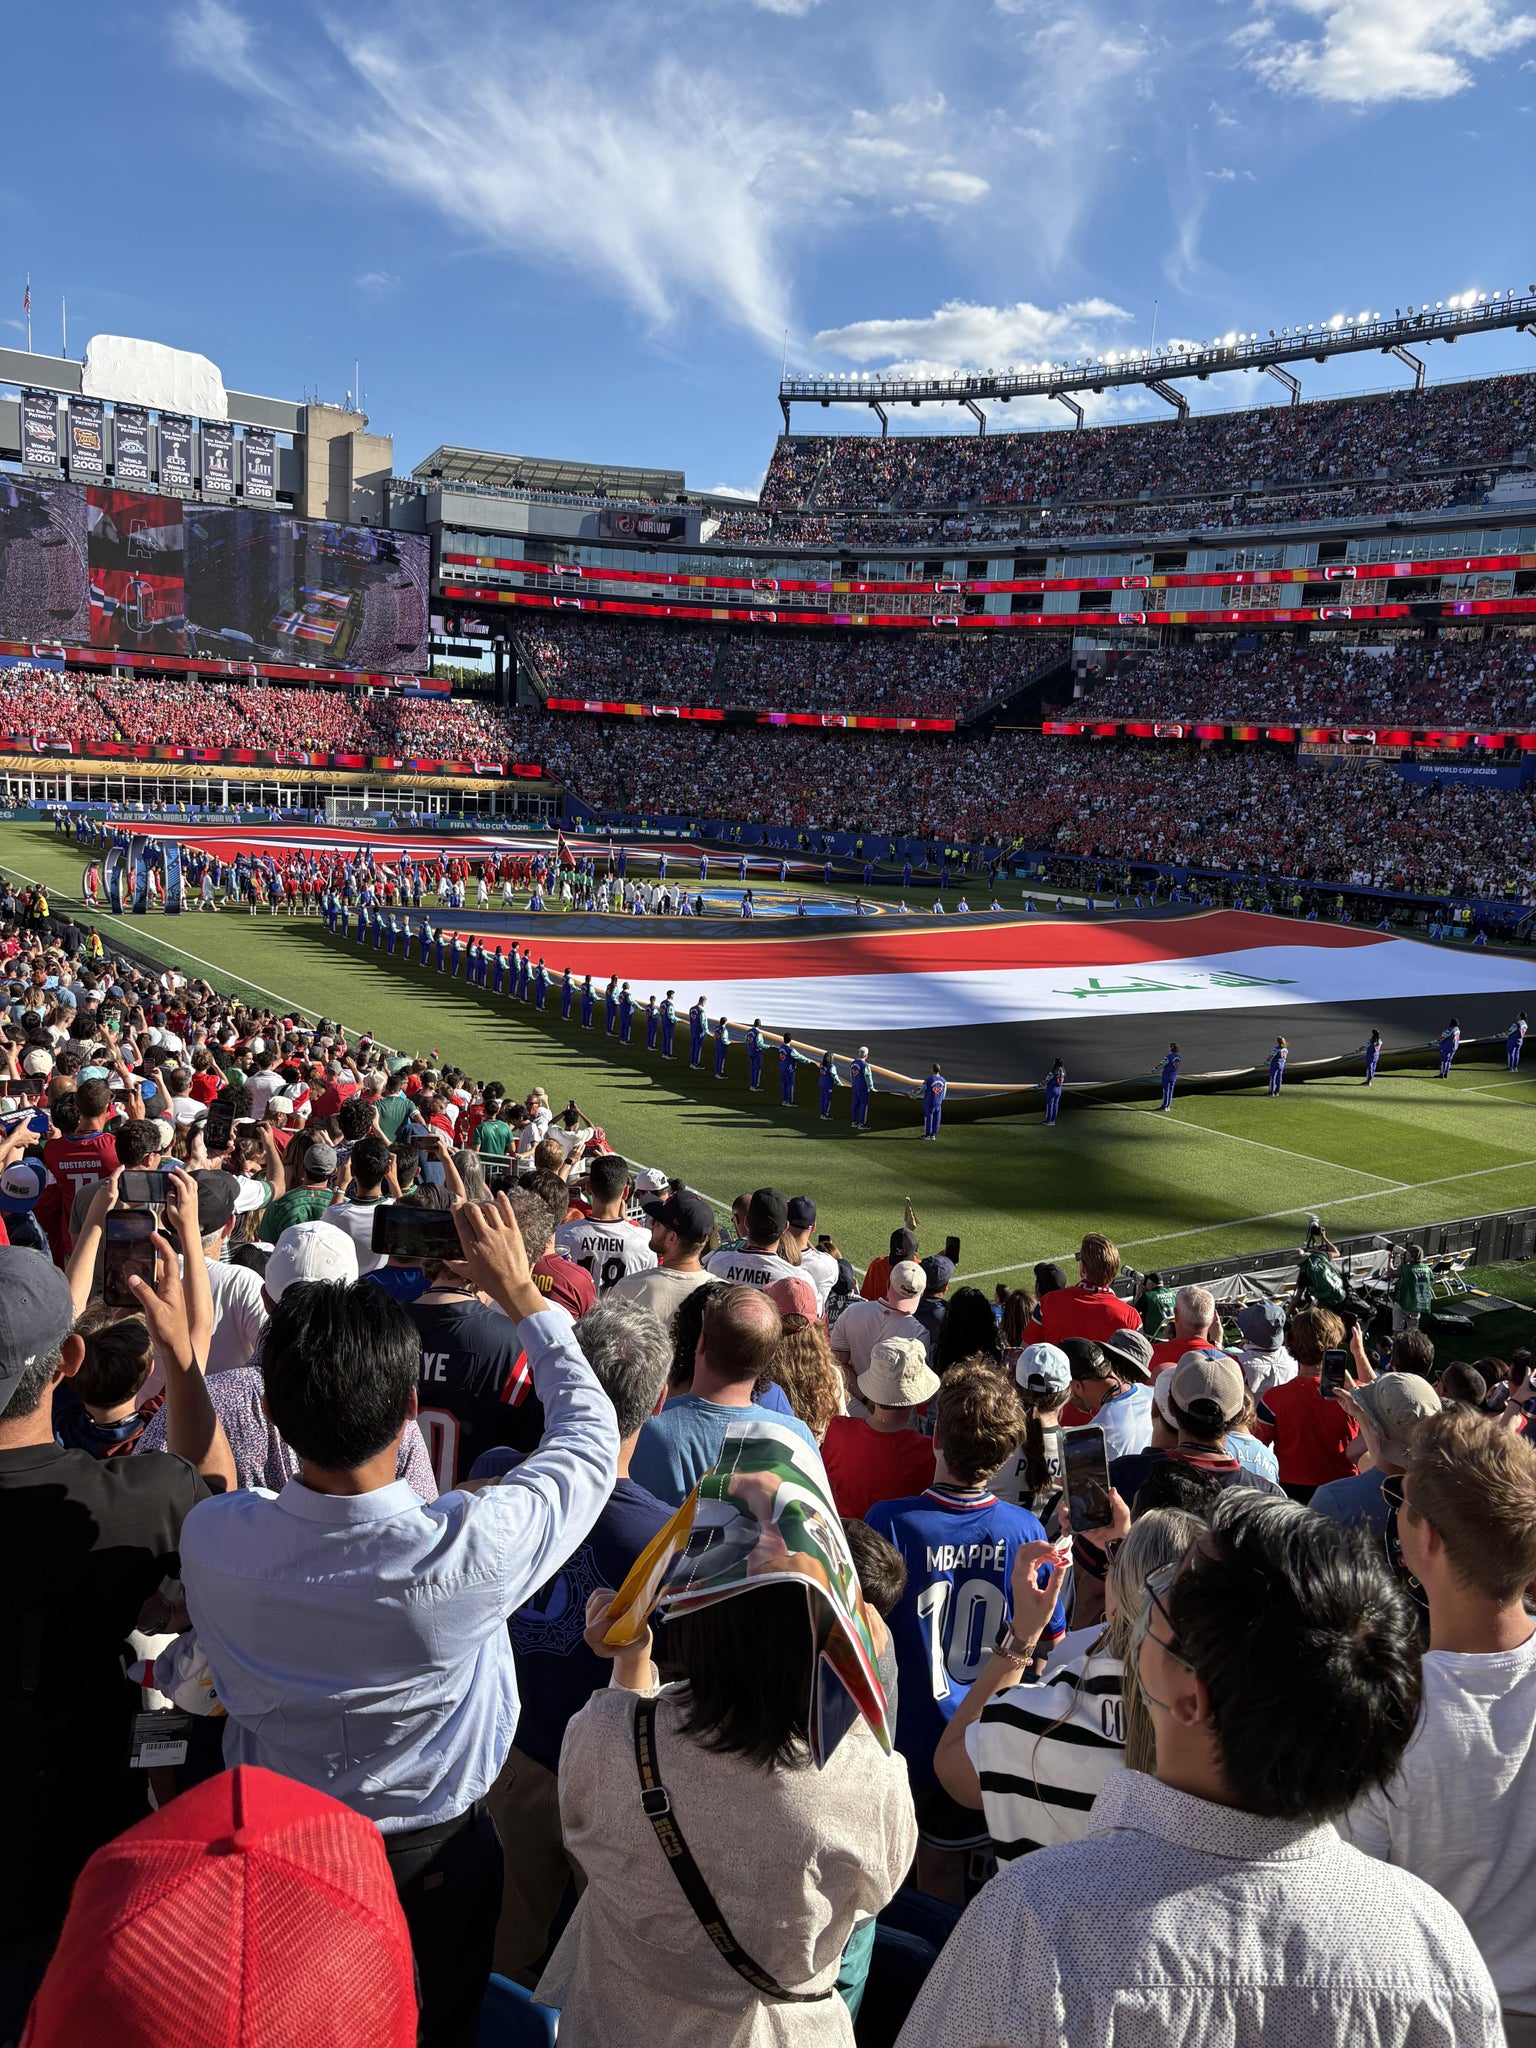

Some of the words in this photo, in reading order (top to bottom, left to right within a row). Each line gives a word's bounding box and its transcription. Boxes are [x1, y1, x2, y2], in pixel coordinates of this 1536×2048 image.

[28, 412, 53, 421] PATRIOTS
[75, 420, 99, 428] PATRIOTS
[120, 427, 144, 435] PATRIOTS
[165, 434, 187, 443] PATRIOTS
[31, 442, 51, 451] WORLD
[207, 442, 229, 450] PATRIOTS
[26, 447, 56, 456] CHAMPIONS
[78, 450, 97, 458] WORLD
[249, 449, 270, 457] PATRIOTS
[27, 452, 55, 464] 2001
[72, 454, 102, 463] CHAMPIONS
[123, 457, 142, 465] WORLD
[166, 457, 187, 466] XLIX
[73, 460, 102, 471] 2003
[118, 461, 147, 470] CHAMPIONS
[119, 467, 147, 478] 2004
[162, 468, 190, 477] CHAMPIONS
[205, 475, 232, 484] CHAMPIONS
[251, 477, 268, 485] WORLD
[206, 481, 231, 491] 2016
[246, 481, 273, 490] CHAMPIONS
[248, 487, 272, 497] 2018
[638, 520, 671, 534] NORWAY
[1434, 766, 1458, 774] WORLD
[1458, 767, 1473, 775] CUP
[1473, 768, 1498, 776] 2026
[162, 813, 188, 821] WORLD
[58, 1160, 102, 1170] GUSTAFSON
[581, 1236, 624, 1252] AYMEN
[726, 1266, 772, 1285] AYMEN
[416, 1352, 450, 1383] YE
[926, 1538, 1007, 1573] MBAPPÉ
[917, 1577, 1010, 1701] 10
